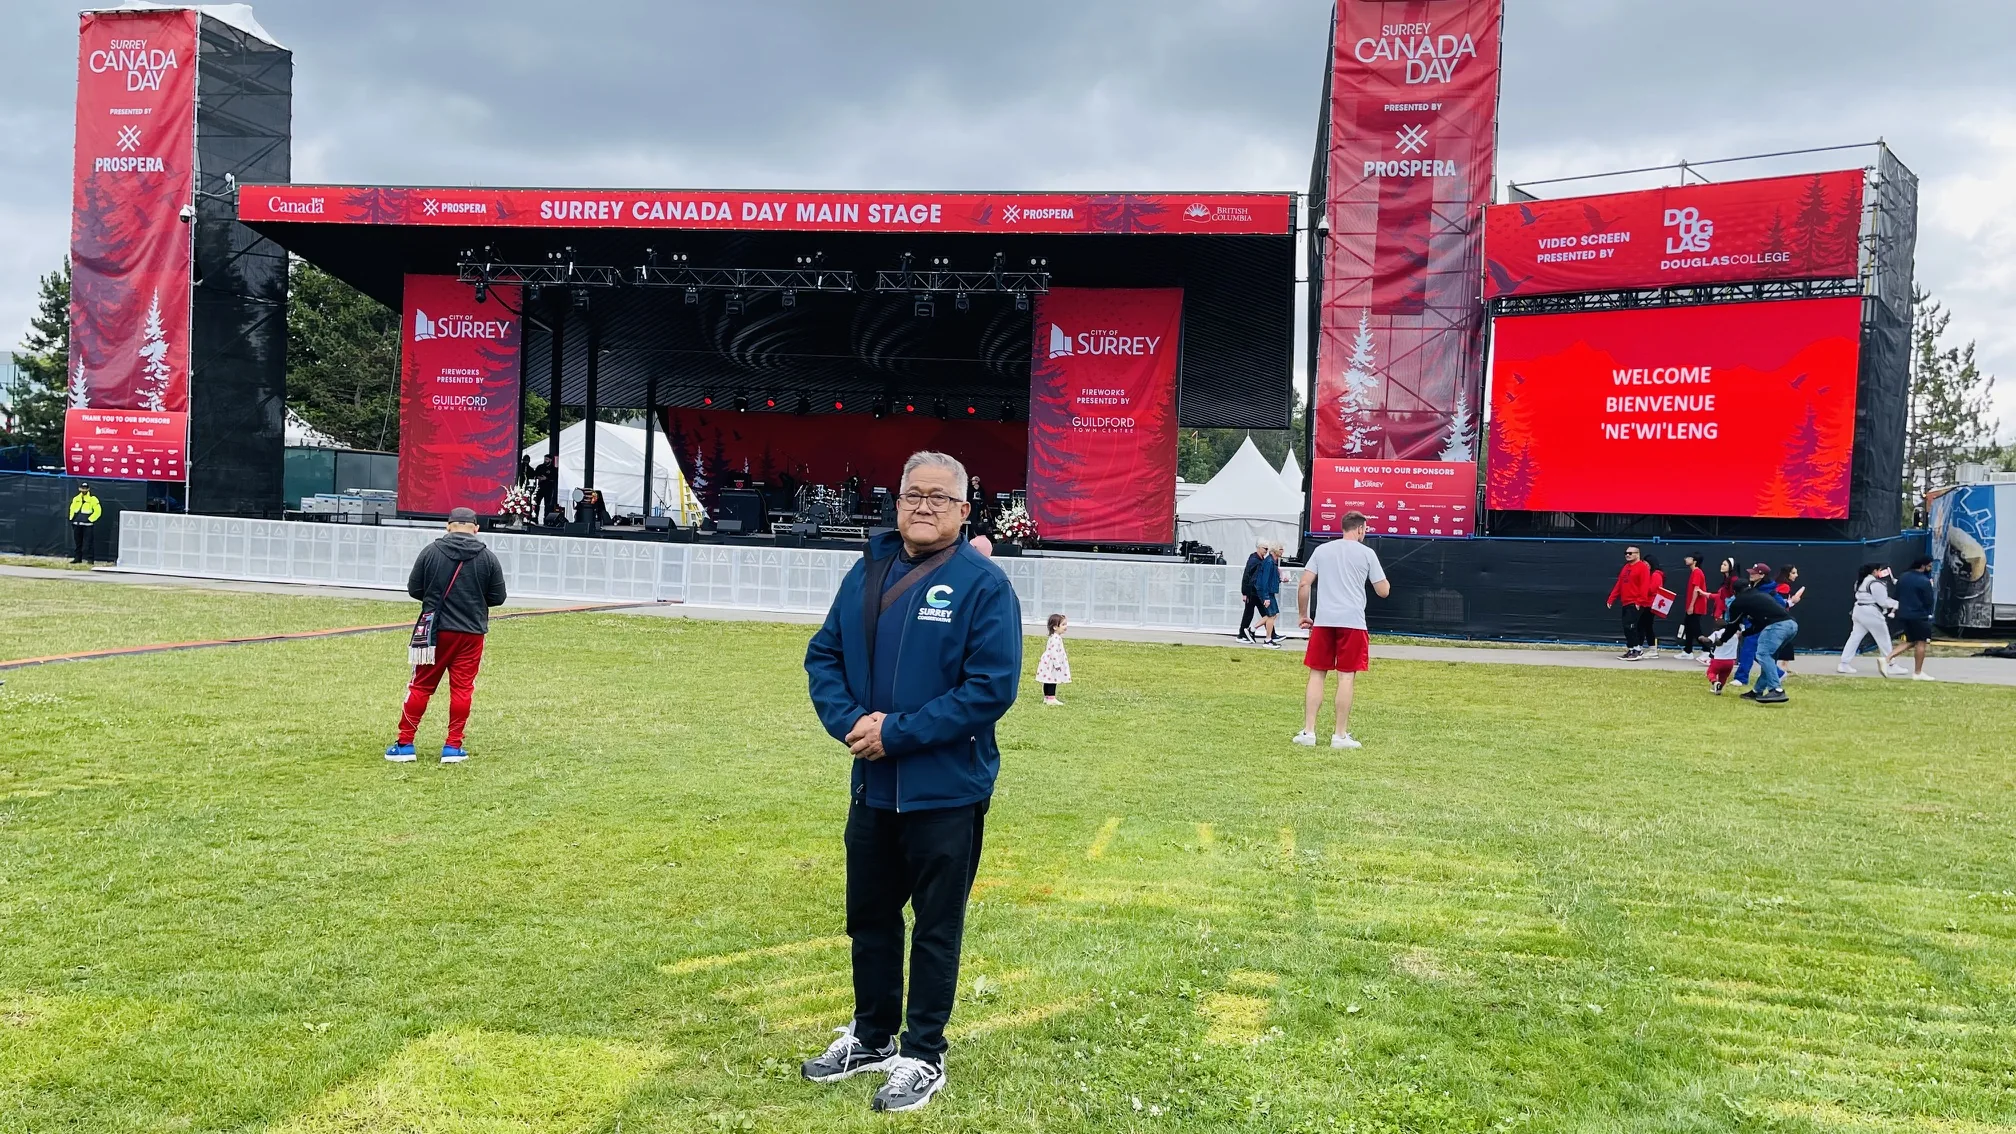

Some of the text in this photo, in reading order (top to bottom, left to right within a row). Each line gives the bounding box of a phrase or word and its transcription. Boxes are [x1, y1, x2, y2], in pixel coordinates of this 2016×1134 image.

[1382, 23, 1431, 36] SURREY
[110, 39, 147, 49] SURREY
[1354, 33, 1477, 63] CANADA
[89, 49, 178, 73] CANADA
[1405, 59, 1458, 84] DAY
[127, 70, 165, 91] DAY
[1384, 103, 1442, 112] PRESENTED BY
[95, 157, 164, 173] PROSPERA
[1364, 160, 1456, 177] PROSPERA
[268, 197, 324, 214] Canada
[441, 202, 487, 214] PROSPERA
[540, 200, 942, 224] SURREY CANADA DAY MAIN STAGE
[1217, 206, 1248, 214] BRITISH
[1023, 208, 1074, 220] PROSPERA
[1212, 214, 1252, 222] COLUMBIA
[1538, 232, 1630, 249] VIDEO SCREEN
[1537, 248, 1614, 263] PRESENTED BY
[437, 318, 509, 338] SURREY
[1077, 333, 1160, 355] SURREY
[1612, 366, 1712, 386] WELCOME
[432, 395, 488, 406] GUILDFORD
[1606, 394, 1716, 413] BIENVENUE
[82, 414, 101, 422] THANK
[1072, 417, 1135, 427] GUILDFORD
[1601, 422, 1718, 440] 'NE'WI'LENG
[1413, 467, 1454, 475] SPONSORS
[918, 608, 953, 618] SURREY
